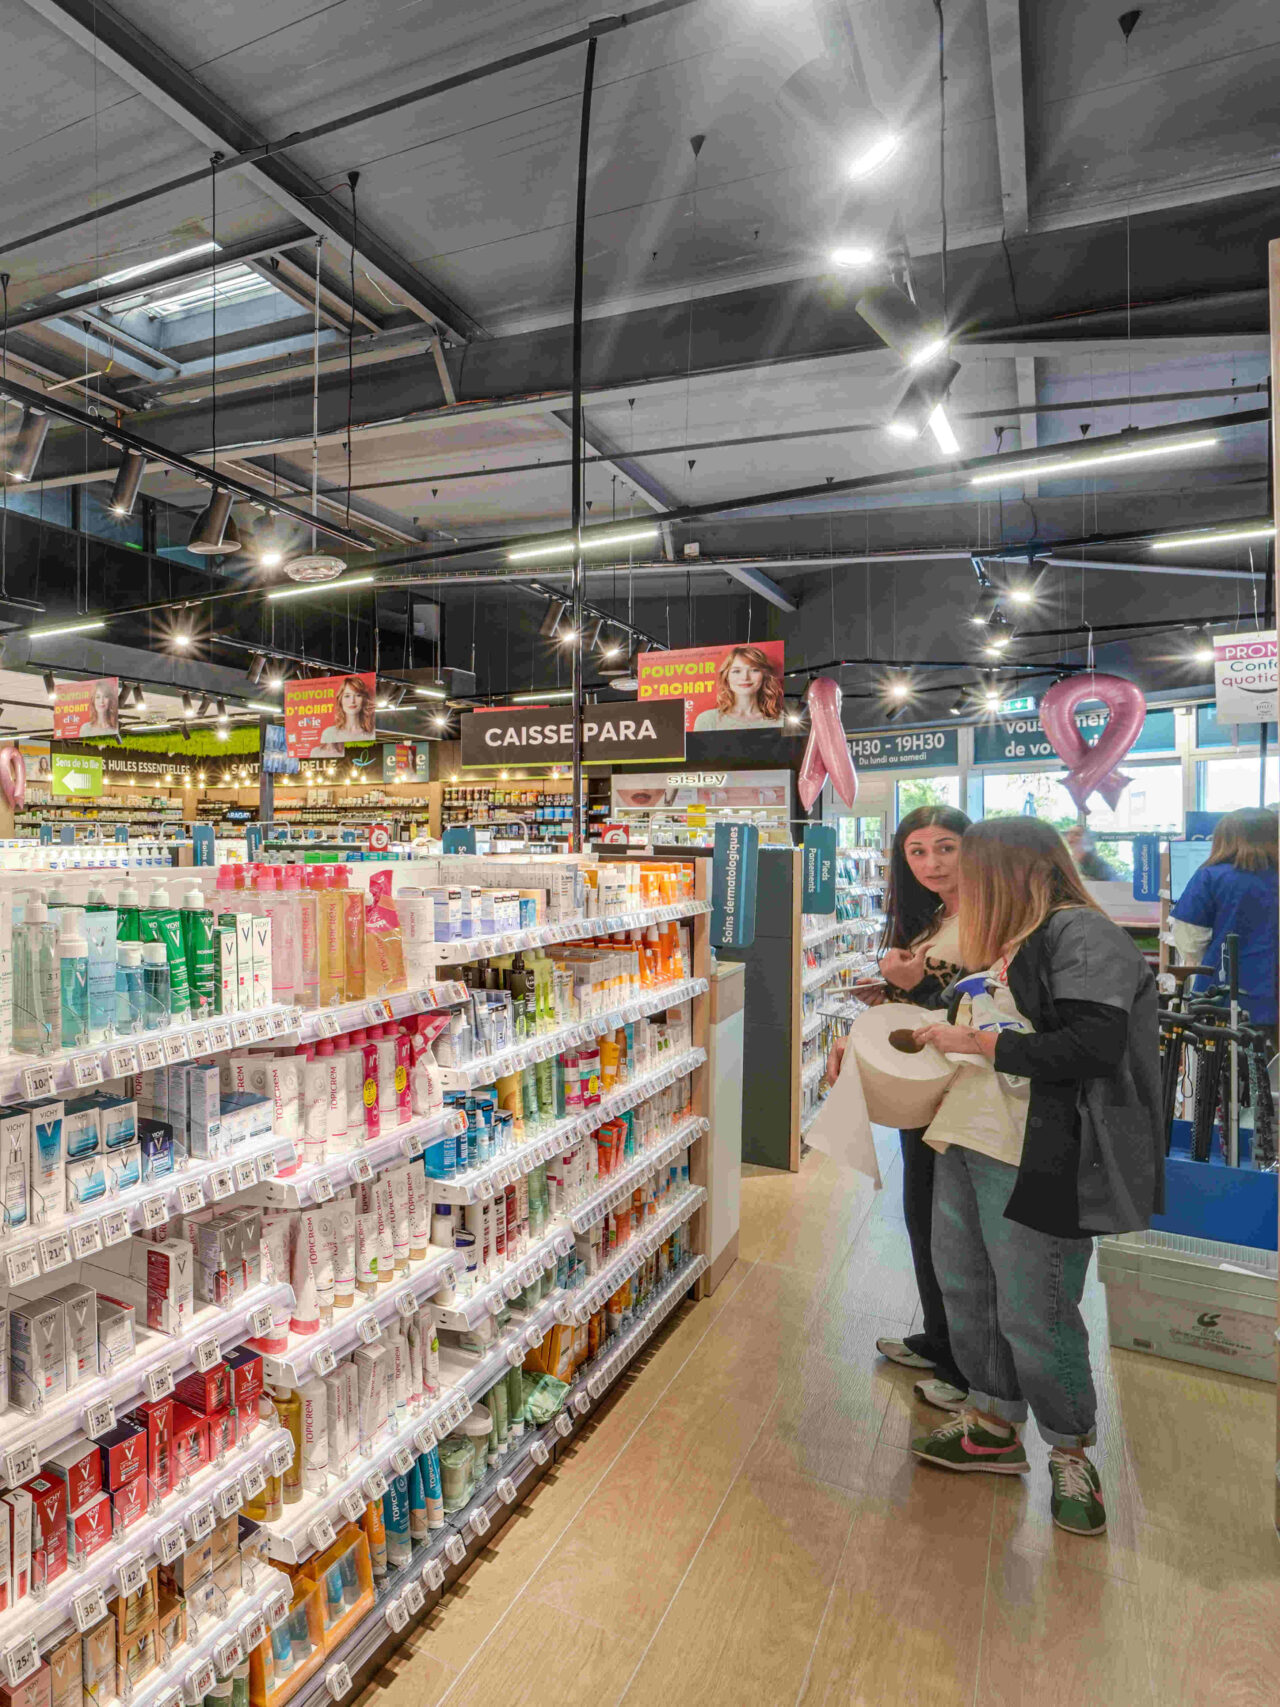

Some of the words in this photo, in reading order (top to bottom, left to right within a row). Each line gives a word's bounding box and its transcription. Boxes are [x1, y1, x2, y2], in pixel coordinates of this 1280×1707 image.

[641, 661, 716, 679] POUVOIR
[287, 688, 335, 701] POUVOIR
[640, 680, 715, 697] D'ACHAT
[286, 703, 334, 716] D'ACHAT
[485, 723, 575, 747] CAISSE
[584, 719, 657, 742] PARA
[896, 733, 945, 752] 19H30
[1005, 741, 1025, 757] de
[56, 758, 71, 768] Sens
[72, 758, 81, 768] de
[858, 757, 869, 765] Du
[870, 755, 887, 764] lundi
[899, 752, 927, 762] samedi
[108, 759, 136, 772] HUILES
[138, 762, 191, 775] ESSENTIELLES
[231, 762, 260, 774] SANT
[667, 772, 727, 787] sisley
[724, 826, 739, 916] dermatologiques
[822, 860, 830, 881] Pieds
[165, 921, 180, 930] VICHY
[723, 918, 733, 943] Soins
[272, 1069, 284, 1120] TOPICREM
[40, 1108, 59, 1119] VICHY
[6, 1122, 25, 1132] VICHY
[152, 1130, 165, 1138] VICHY
[407, 1171, 415, 1215] TOPICREM
[307, 1216, 317, 1265] TOPICREM
[72, 1298, 89, 1310] VICHY
[39, 1313, 57, 1325] VICHY
[154, 1405, 168, 1417] VICHY
[305, 1399, 313, 1444] TOPICREM
[123, 1438, 136, 1448] VICHY
[43, 1491, 61, 1506] VICHY
[86, 1505, 100, 1517] VICHY
[94, 1625, 110, 1641] VICHY
